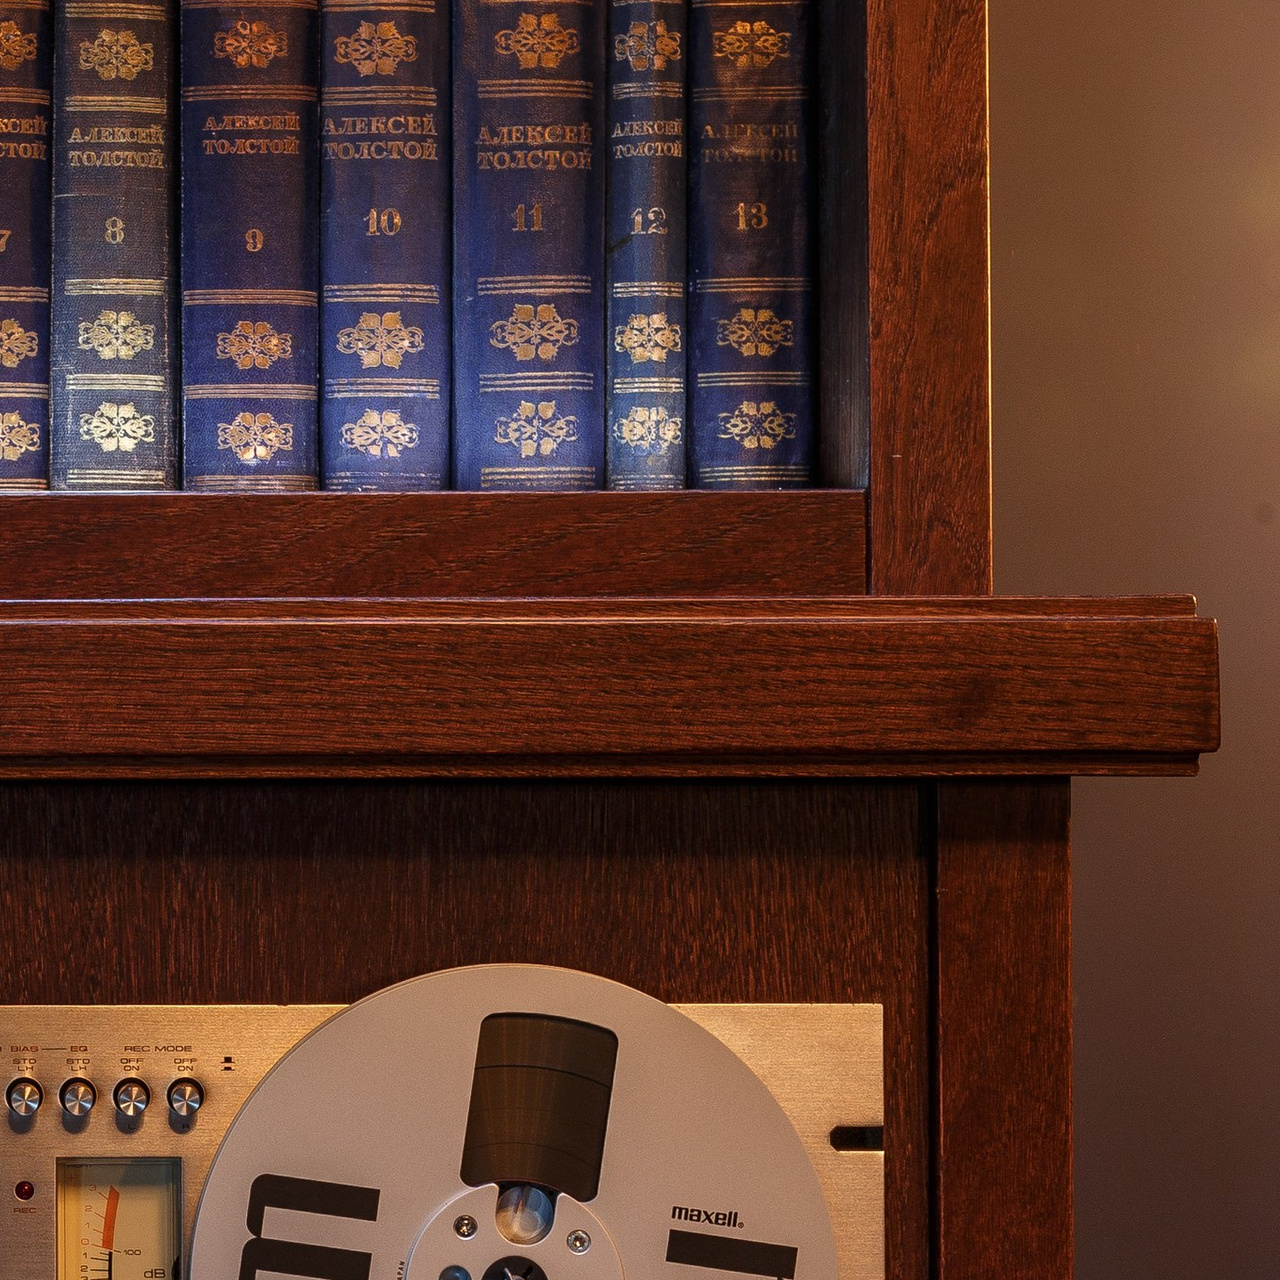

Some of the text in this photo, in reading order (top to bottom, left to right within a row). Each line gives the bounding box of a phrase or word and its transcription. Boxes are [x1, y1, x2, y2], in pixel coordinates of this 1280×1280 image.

[203, 111, 301, 131] АЛЕКСЕЙ
[322, 113, 438, 136] АЛЕКСЕЙ
[611, 118, 683, 138] АЛЕКСЕЙ
[68, 124, 165, 145] АЛЕКСЕЙ
[475, 122, 592, 145] АЛЕКСЕЙ
[203, 136, 300, 155] ТОЛСТОЙ
[324, 138, 438, 161] ТОЛСТОЙ
[613, 140, 683, 159] ТОЛСТОЙ
[69, 149, 165, 169] ТОЛСТОЙ
[477, 147, 592, 170] ТОЛСТОЙ
[363, 207, 401, 236] 10
[511, 204, 544, 232] 11
[630, 207, 668, 235] 12
[735, 202, 769, 233] 13
[104, 217, 125, 245] 8
[245, 228, 264, 252] 9
[10, 1045, 88, 1053] BIAS EQ
[124, 1045, 193, 1053] REC MODE
[672, 1206, 738, 1227] maxell
[143, 1268, 166, 1279] dB
